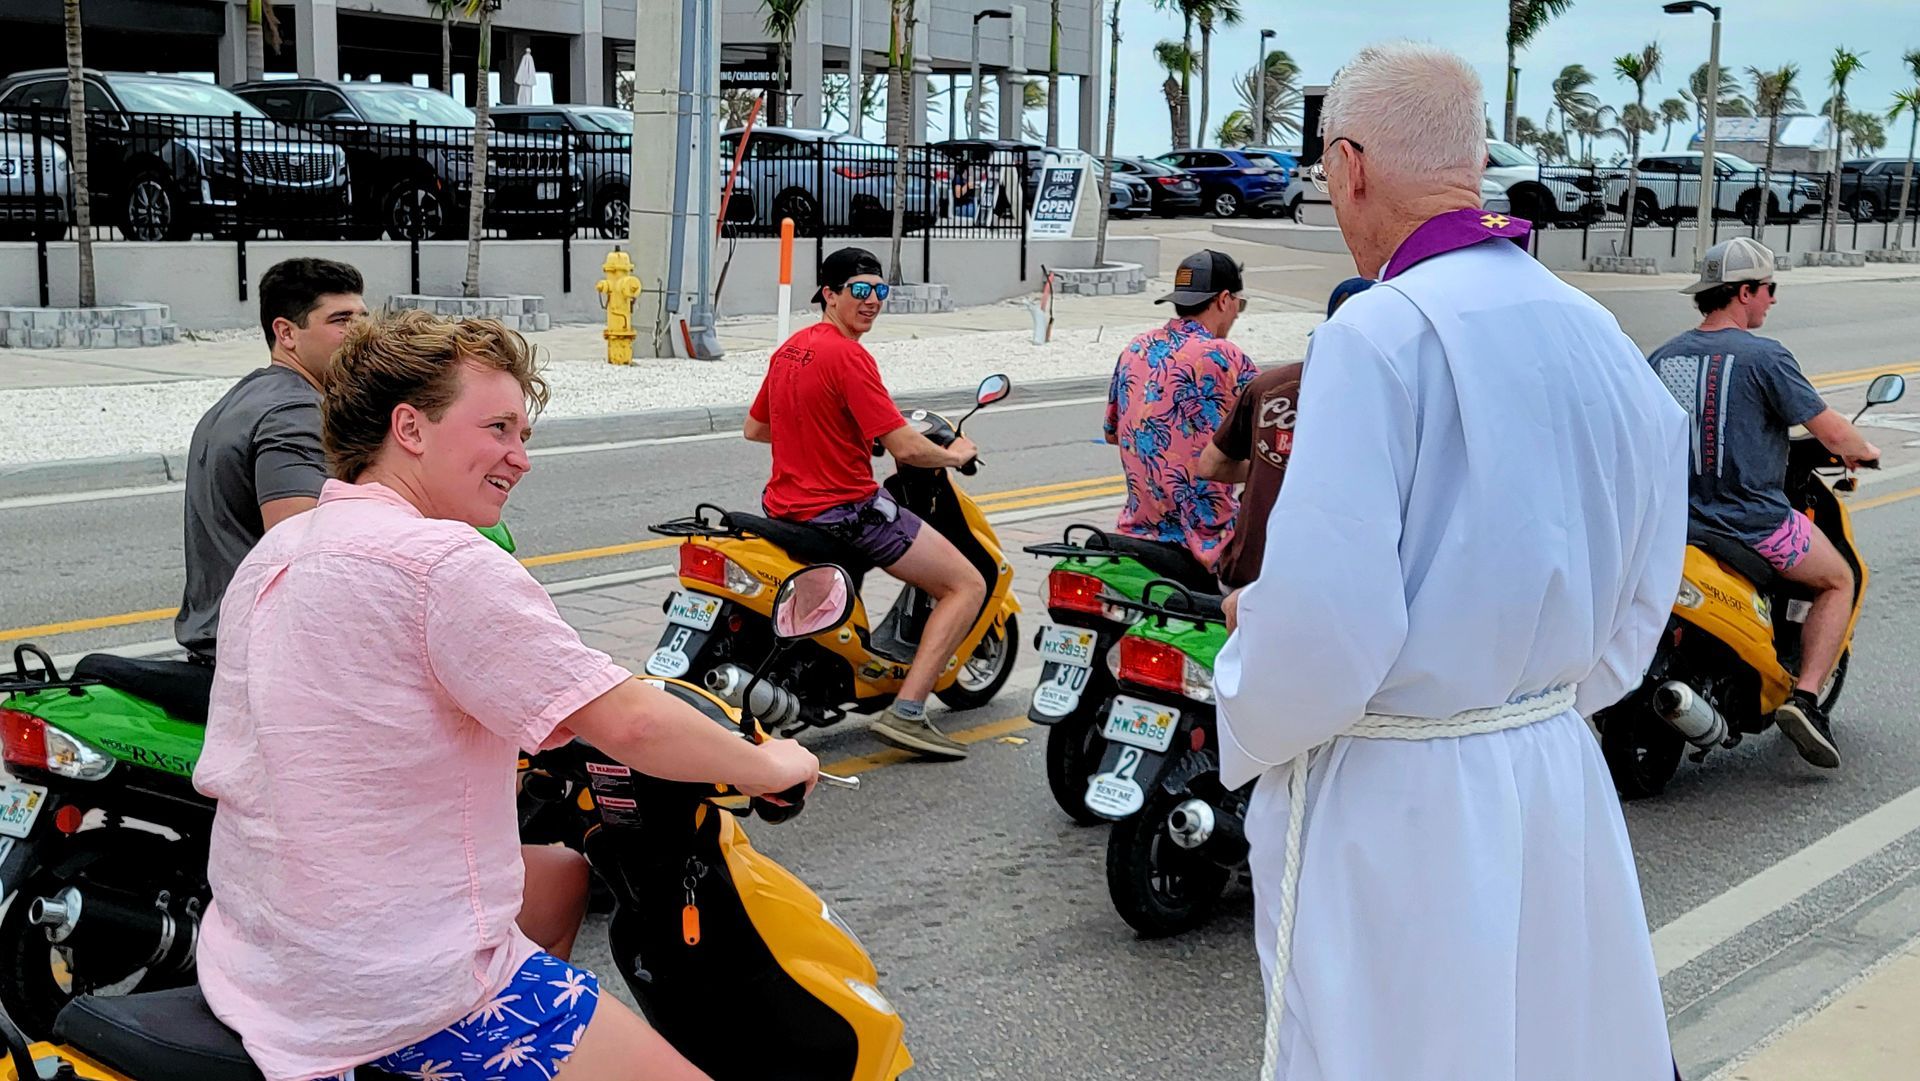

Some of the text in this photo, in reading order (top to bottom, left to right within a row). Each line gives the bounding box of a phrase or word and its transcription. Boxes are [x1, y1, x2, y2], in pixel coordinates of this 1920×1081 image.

[720, 71, 789, 83] ING/CHARGING OY
[1038, 200, 1074, 213] OPEN
[1259, 397, 1296, 429] Co
[670, 630, 688, 653] 5
[1057, 663, 1087, 691] 30
[1115, 750, 1138, 780] 2
[1096, 784, 1117, 798] RENT
[1117, 791, 1133, 802] ME
